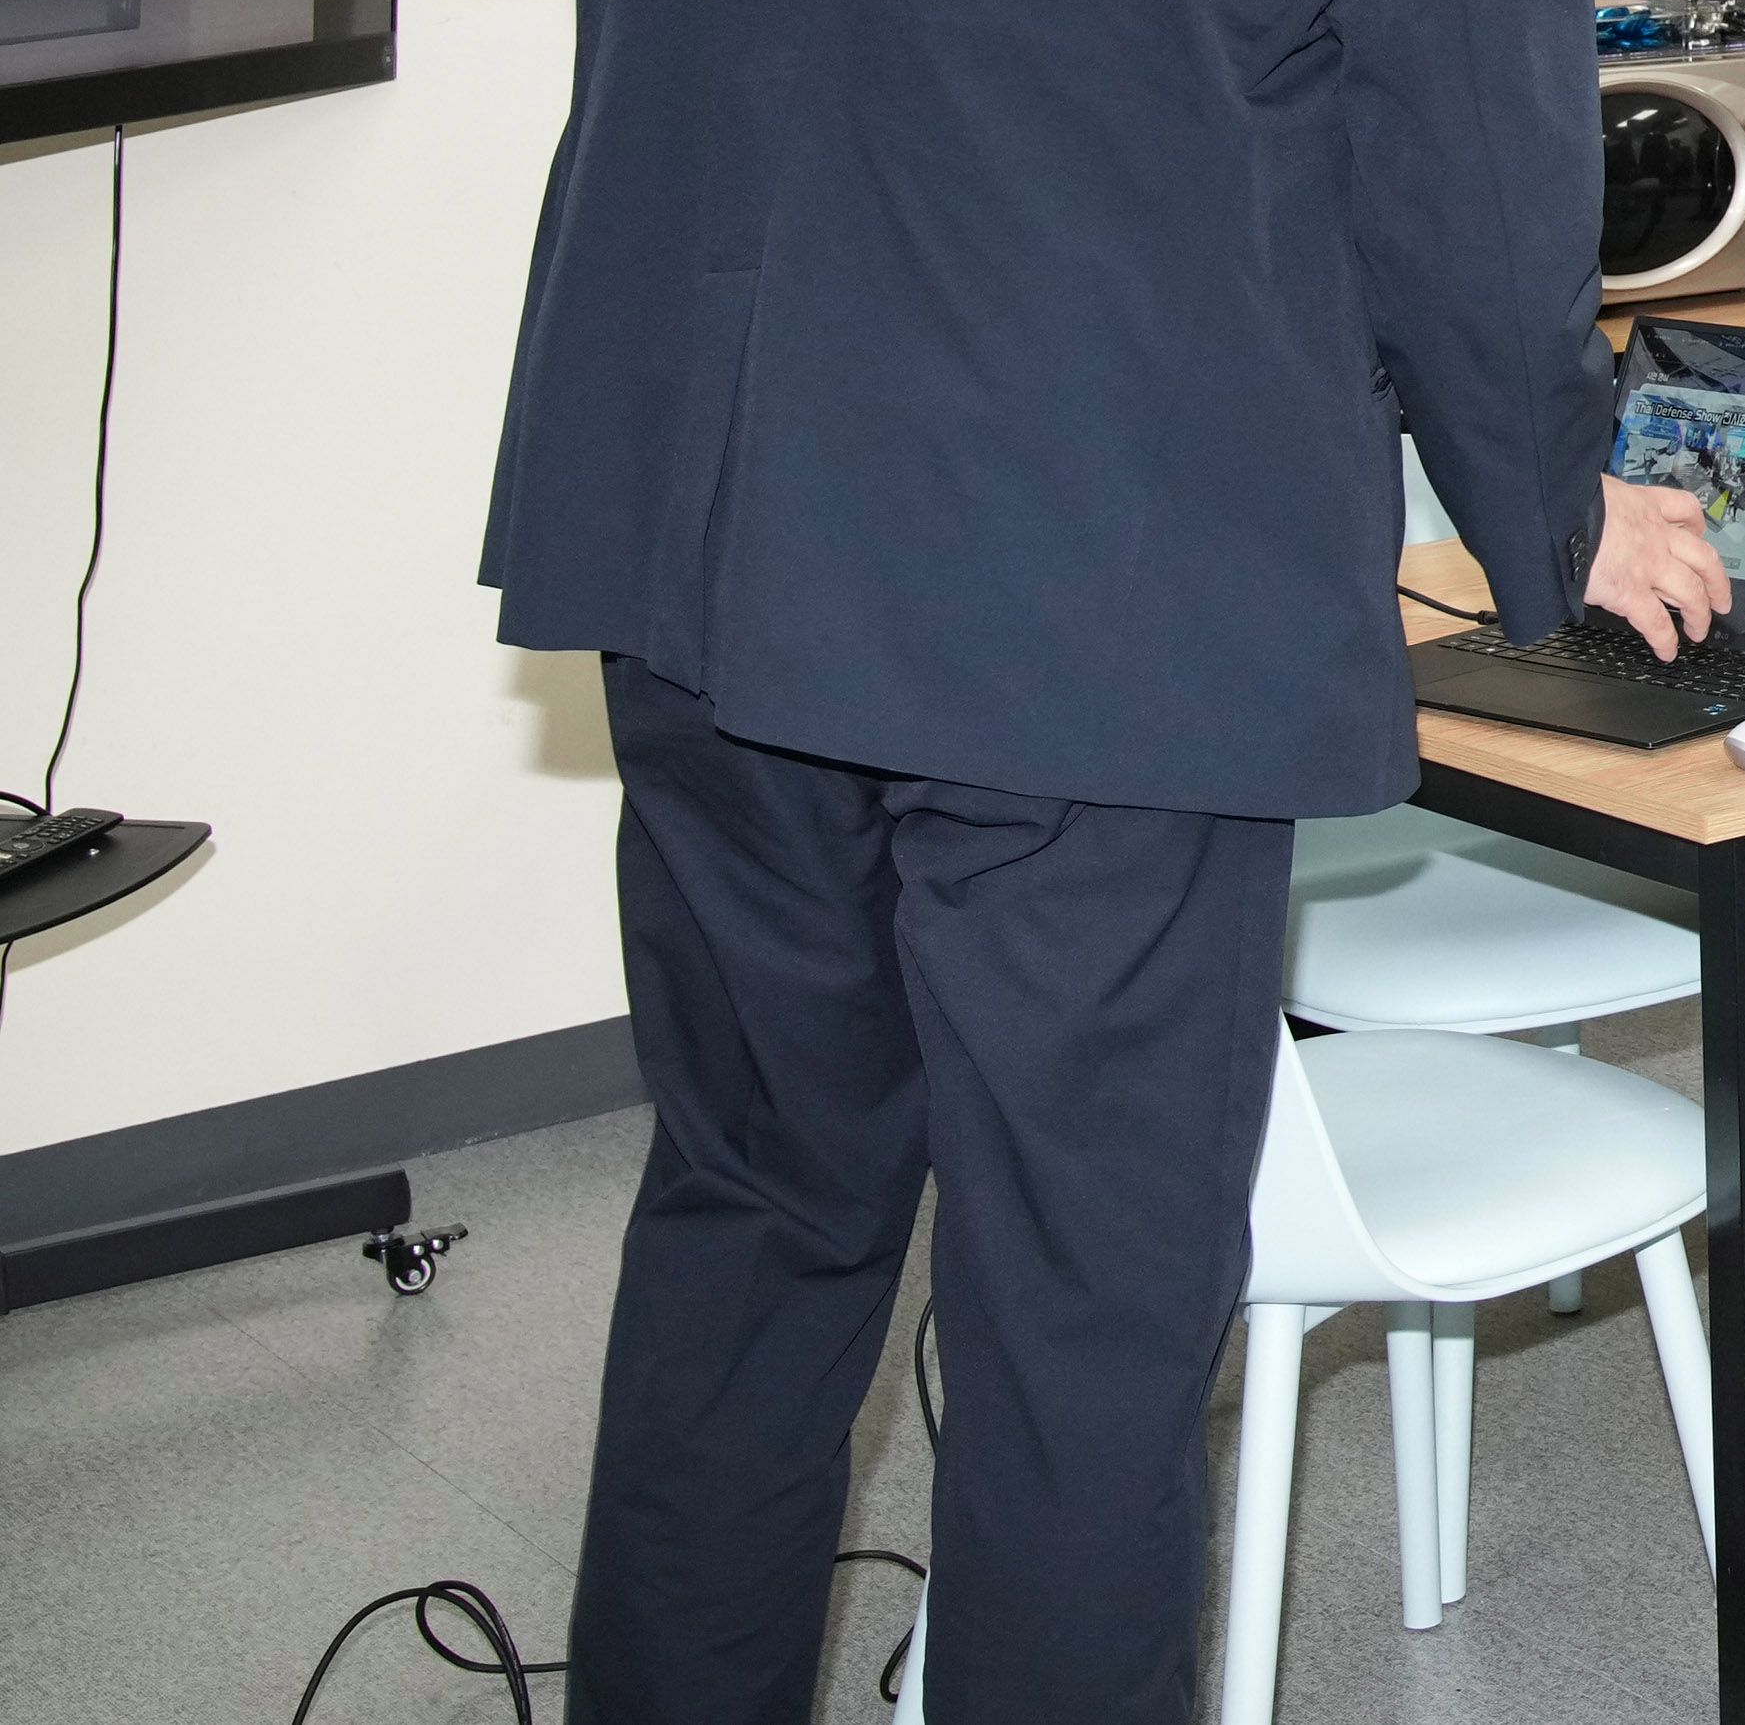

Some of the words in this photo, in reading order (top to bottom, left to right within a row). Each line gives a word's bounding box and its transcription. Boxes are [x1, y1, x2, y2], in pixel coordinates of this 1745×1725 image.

[1635, 401, 1653, 414] Thai
[1655, 404, 1693, 420] Defense
[1694, 408, 1721, 424] Show
